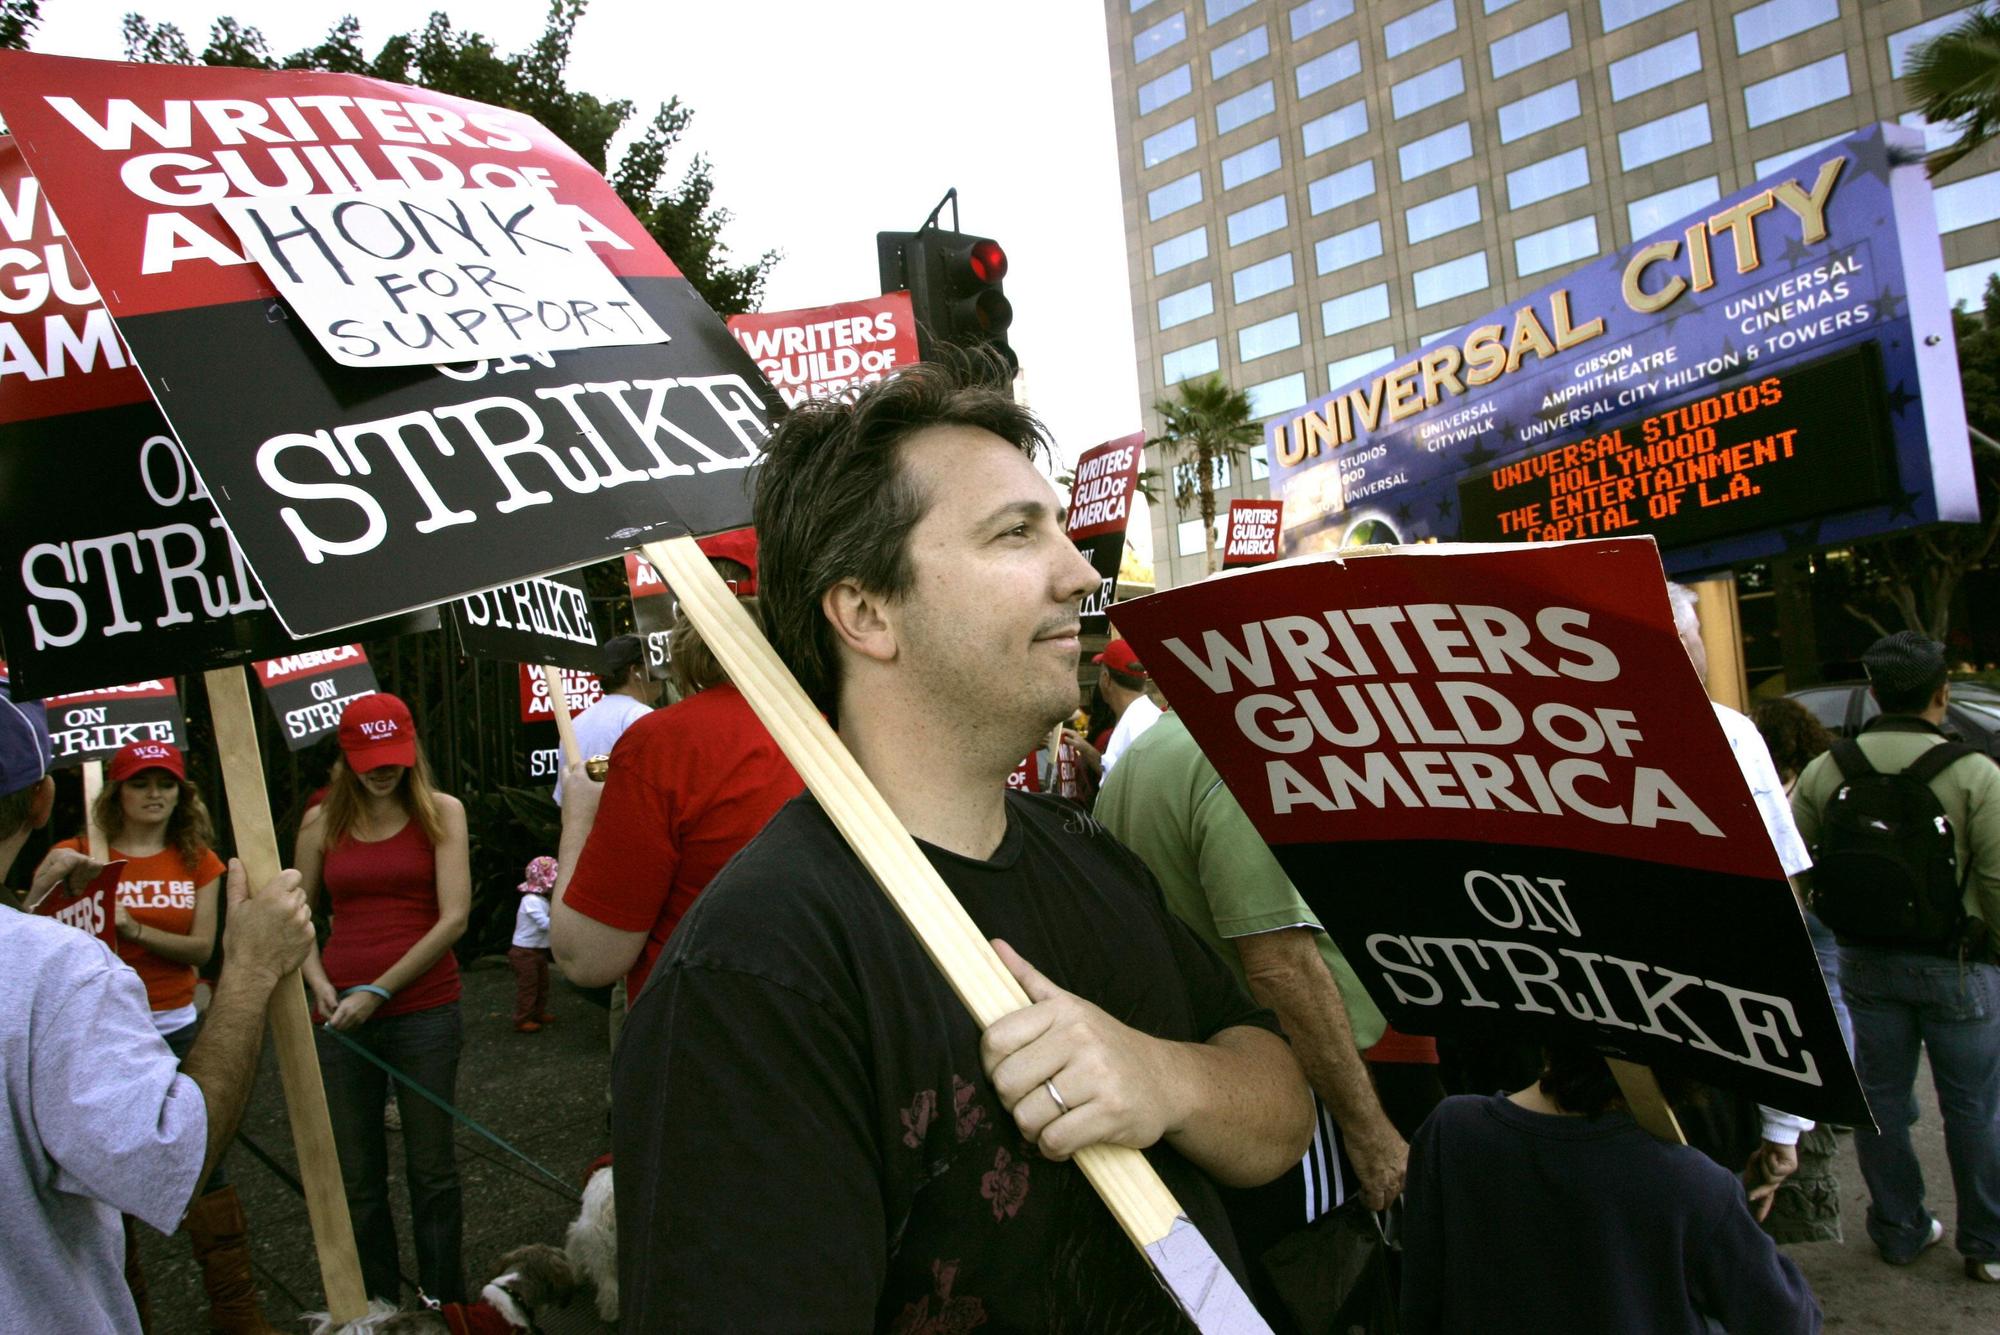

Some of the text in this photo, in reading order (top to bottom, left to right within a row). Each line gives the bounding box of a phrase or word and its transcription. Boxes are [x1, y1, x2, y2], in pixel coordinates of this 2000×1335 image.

[44, 95, 532, 153] WRITERS
[120, 146, 465, 207] GUILD
[246, 198, 574, 287] HONK
[376, 263, 525, 313] FOR
[1274, 156, 1846, 467] UNIVERSAL CITY
[1725, 256, 1862, 320] UNIVERSAL
[1741, 281, 1849, 335] CINEMAS
[328, 300, 645, 358] SUPPORT
[741, 312, 897, 360] WRITERS
[757, 347, 896, 386] GUILD OF
[1520, 304, 1870, 442] UNIVERSAL CITY HILTON & TOWERS
[1541, 346, 1677, 409] AMPHITHEATRE
[1574, 344, 1633, 378] GIBSON
[1422, 401, 1498, 438] UNIVERSAL
[1427, 418, 1495, 453] CITYWALK
[1493, 377, 1783, 491] UNIVERSAL STUDIOS
[140, 435, 211, 507] O
[256, 374, 772, 564] STRIKE
[1078, 446, 1134, 485] WRITERS
[1340, 443, 1388, 472] STUDIOS
[1497, 429, 1798, 535] THE ENTERTAINMENT
[1550, 428, 1716, 496] HOLLYWOOD
[1067, 495, 1126, 532] AMERICA
[1075, 476, 1128, 507] GUILD OF
[1344, 472, 1409, 503] UNIVERSAL
[1526, 473, 1761, 542] CAPITAL OF L.A.
[1233, 508, 1278, 524] WRITERS
[1233, 524, 1275, 540] GUILD OF
[1227, 539, 1276, 556] AMERICA
[21, 517, 273, 651] STRI
[463, 578, 597, 646] STRIKE
[267, 645, 359, 679] AMERICA
[1161, 603, 1620, 694] WRITERS
[310, 678, 338, 701] ON
[532, 677, 588, 697] GILD
[64, 707, 107, 728] ON
[360, 719, 398, 735] WGA
[1234, 681, 1643, 758] GUILD OF
[1007, 771, 1026, 786] OF
[1266, 751, 1726, 838] AMERICA
[122, 894, 195, 909] ALOUS
[169, 881, 195, 894] BE
[1464, 869, 1582, 937] ON
[1365, 933, 1823, 1087] STRIKE
